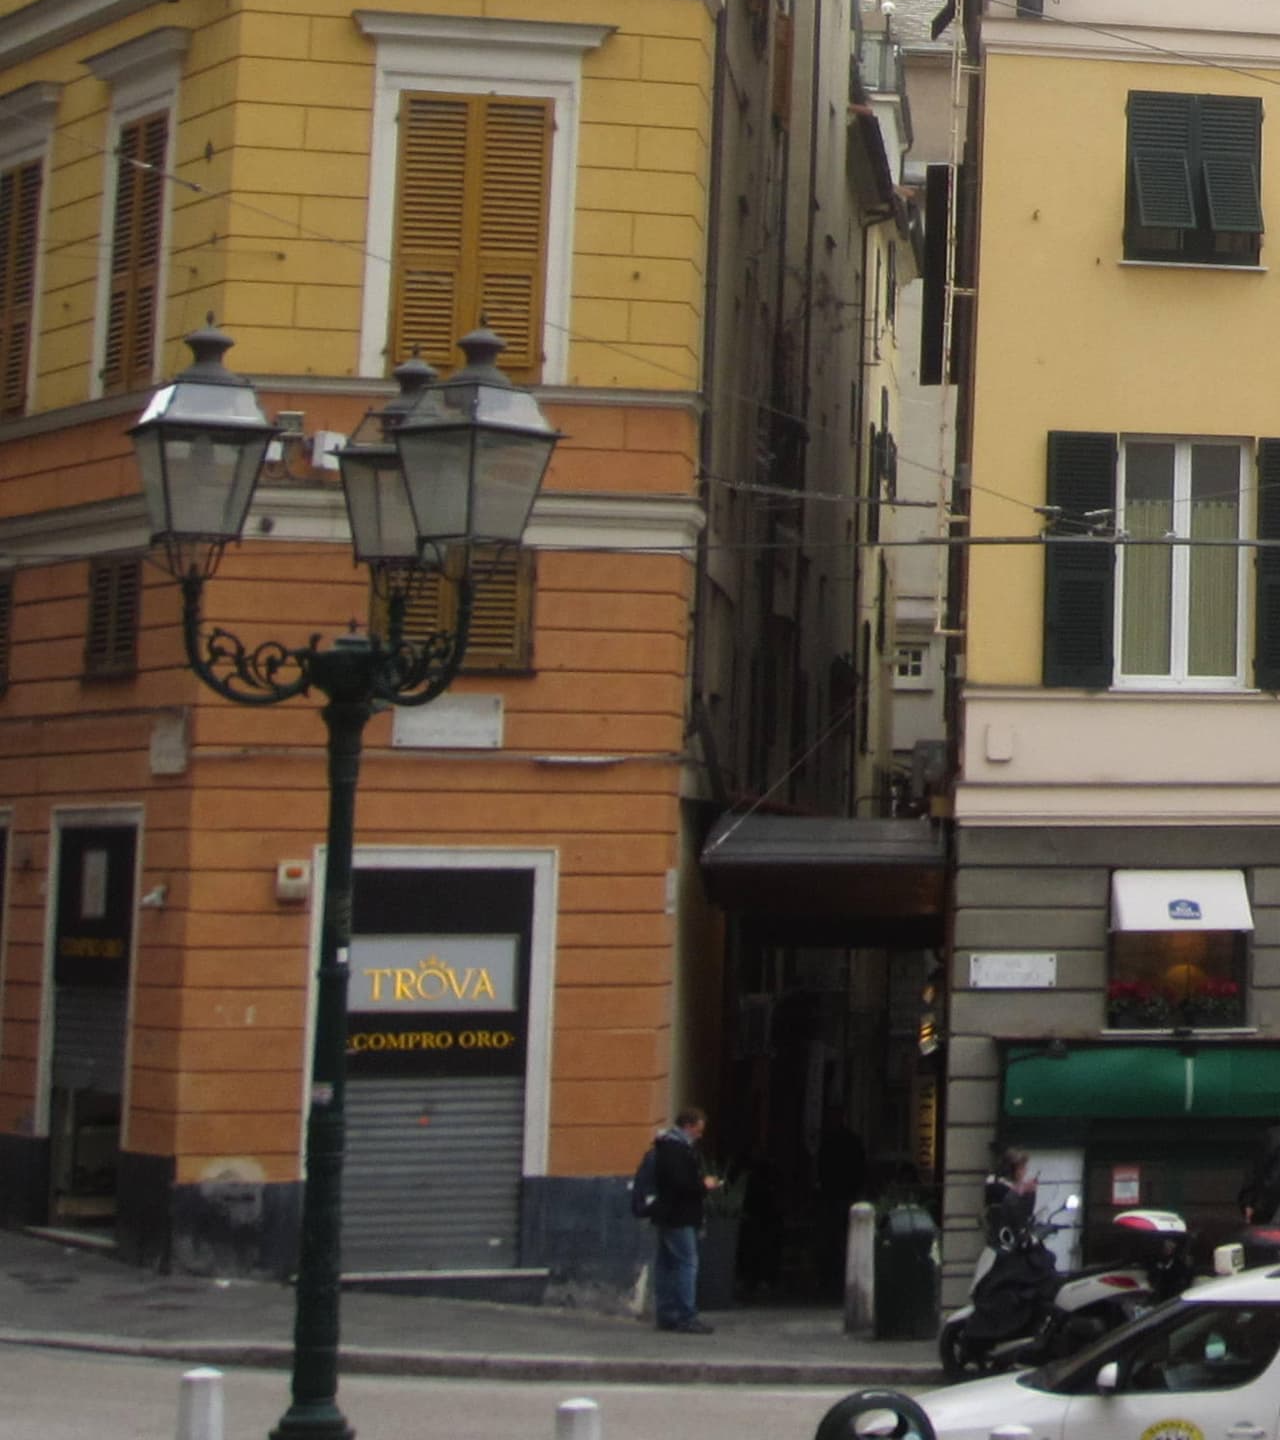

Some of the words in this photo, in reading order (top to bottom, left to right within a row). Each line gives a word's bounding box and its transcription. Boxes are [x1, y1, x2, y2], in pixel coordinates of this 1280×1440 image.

[363, 967, 497, 1002] TROVA
[353, 1032, 453, 1050] COMPRO
[458, 1030, 509, 1049] ORO
